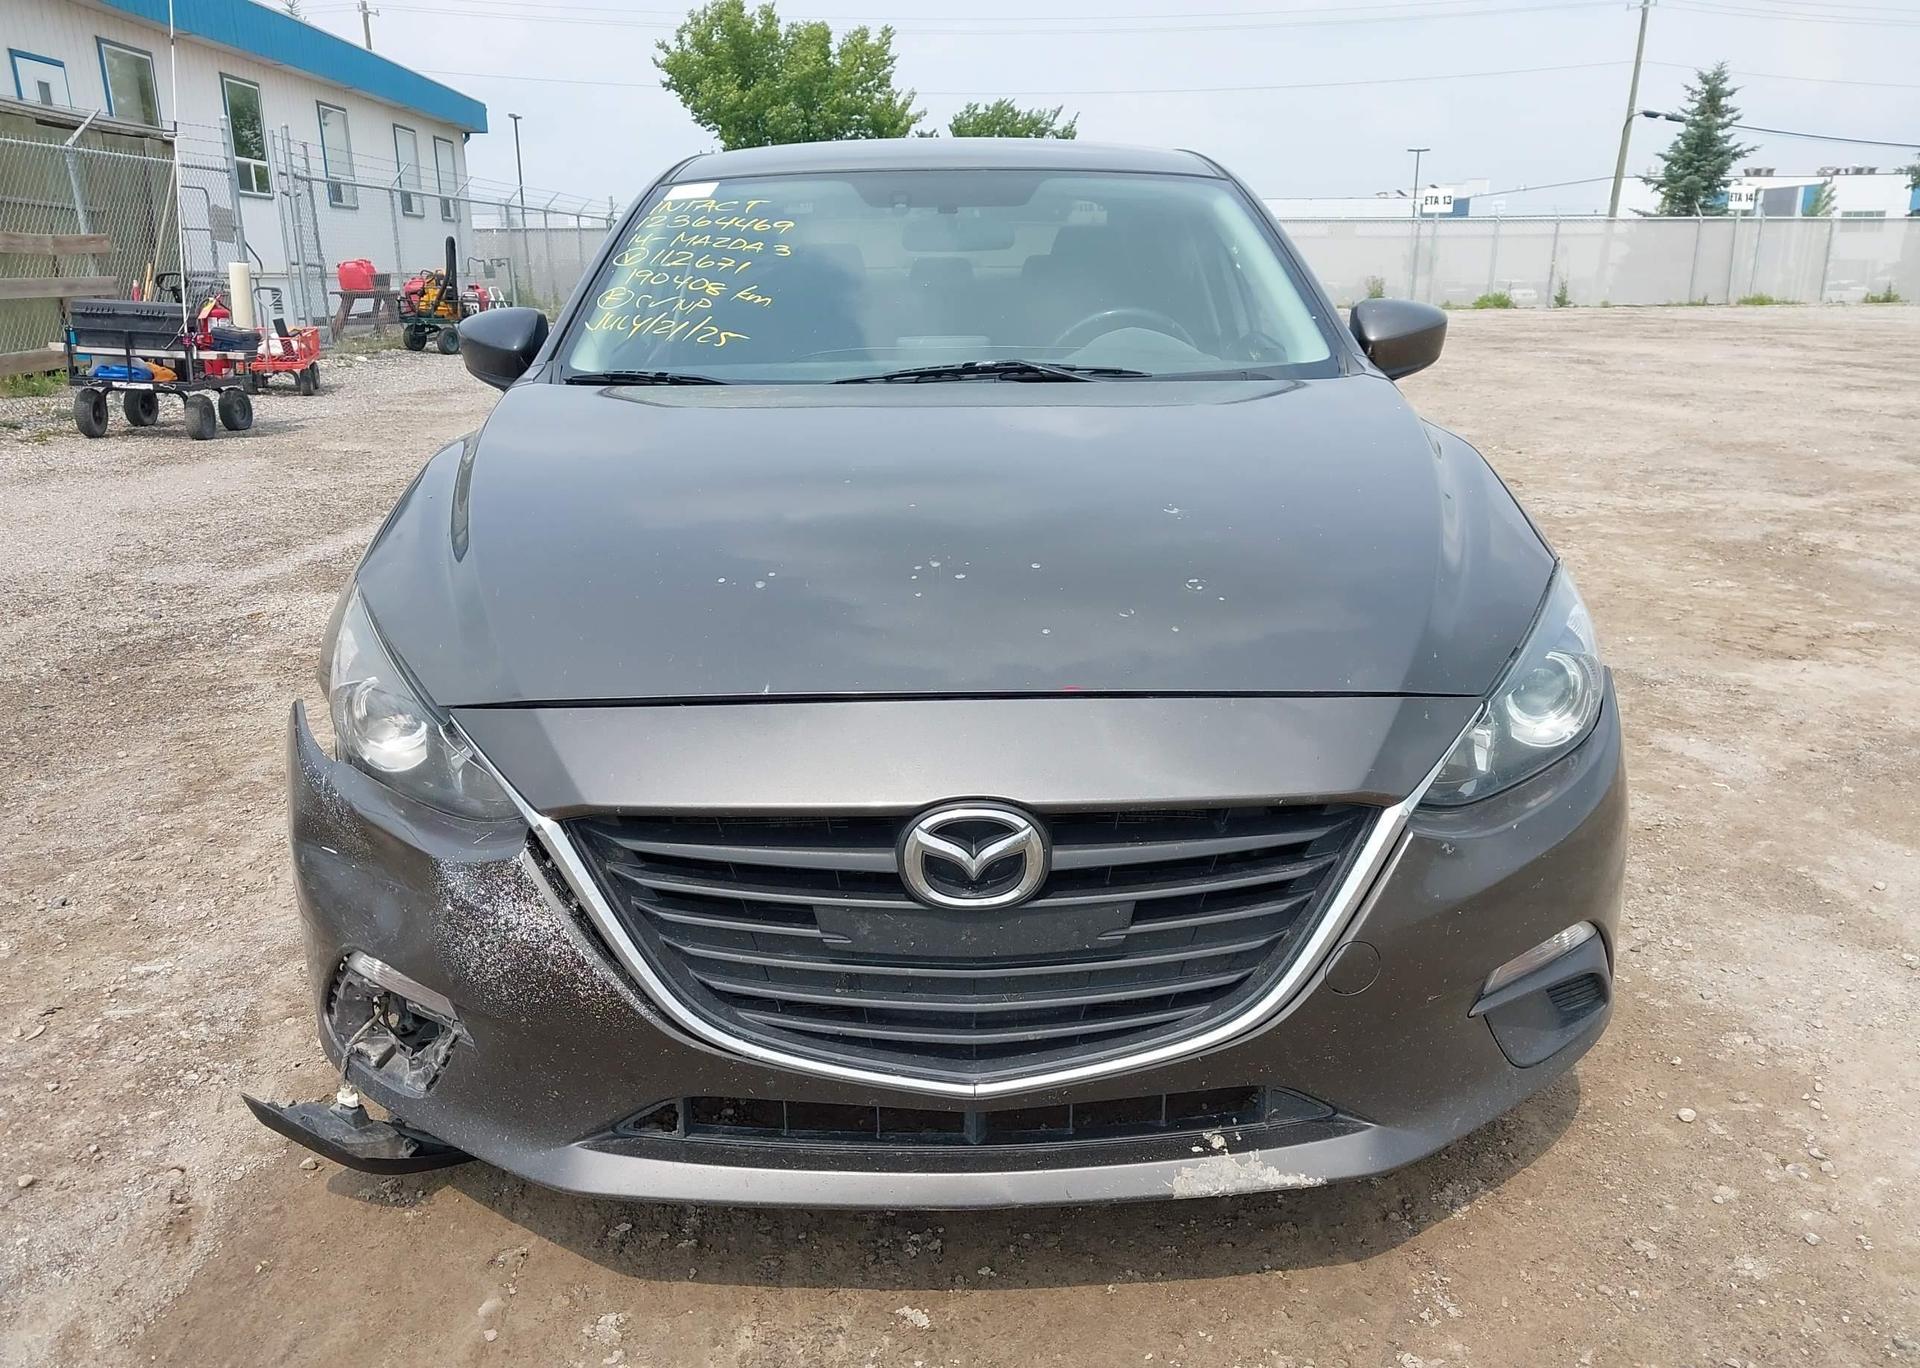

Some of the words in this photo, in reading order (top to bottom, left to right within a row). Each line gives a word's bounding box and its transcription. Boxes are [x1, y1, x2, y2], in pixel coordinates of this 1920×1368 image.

[1425, 195, 1439, 205] ETA
[1443, 195, 1452, 205] 13
[1730, 192, 1742, 202] ETA
[1745, 192, 1753, 202] 14
[650, 199, 770, 216] INTACT
[635, 215, 795, 234] 12364469
[670, 232, 763, 253] MAZDA
[773, 245, 791, 257] 3
[649, 249, 751, 274] 112671
[625, 268, 728, 296] 190408
